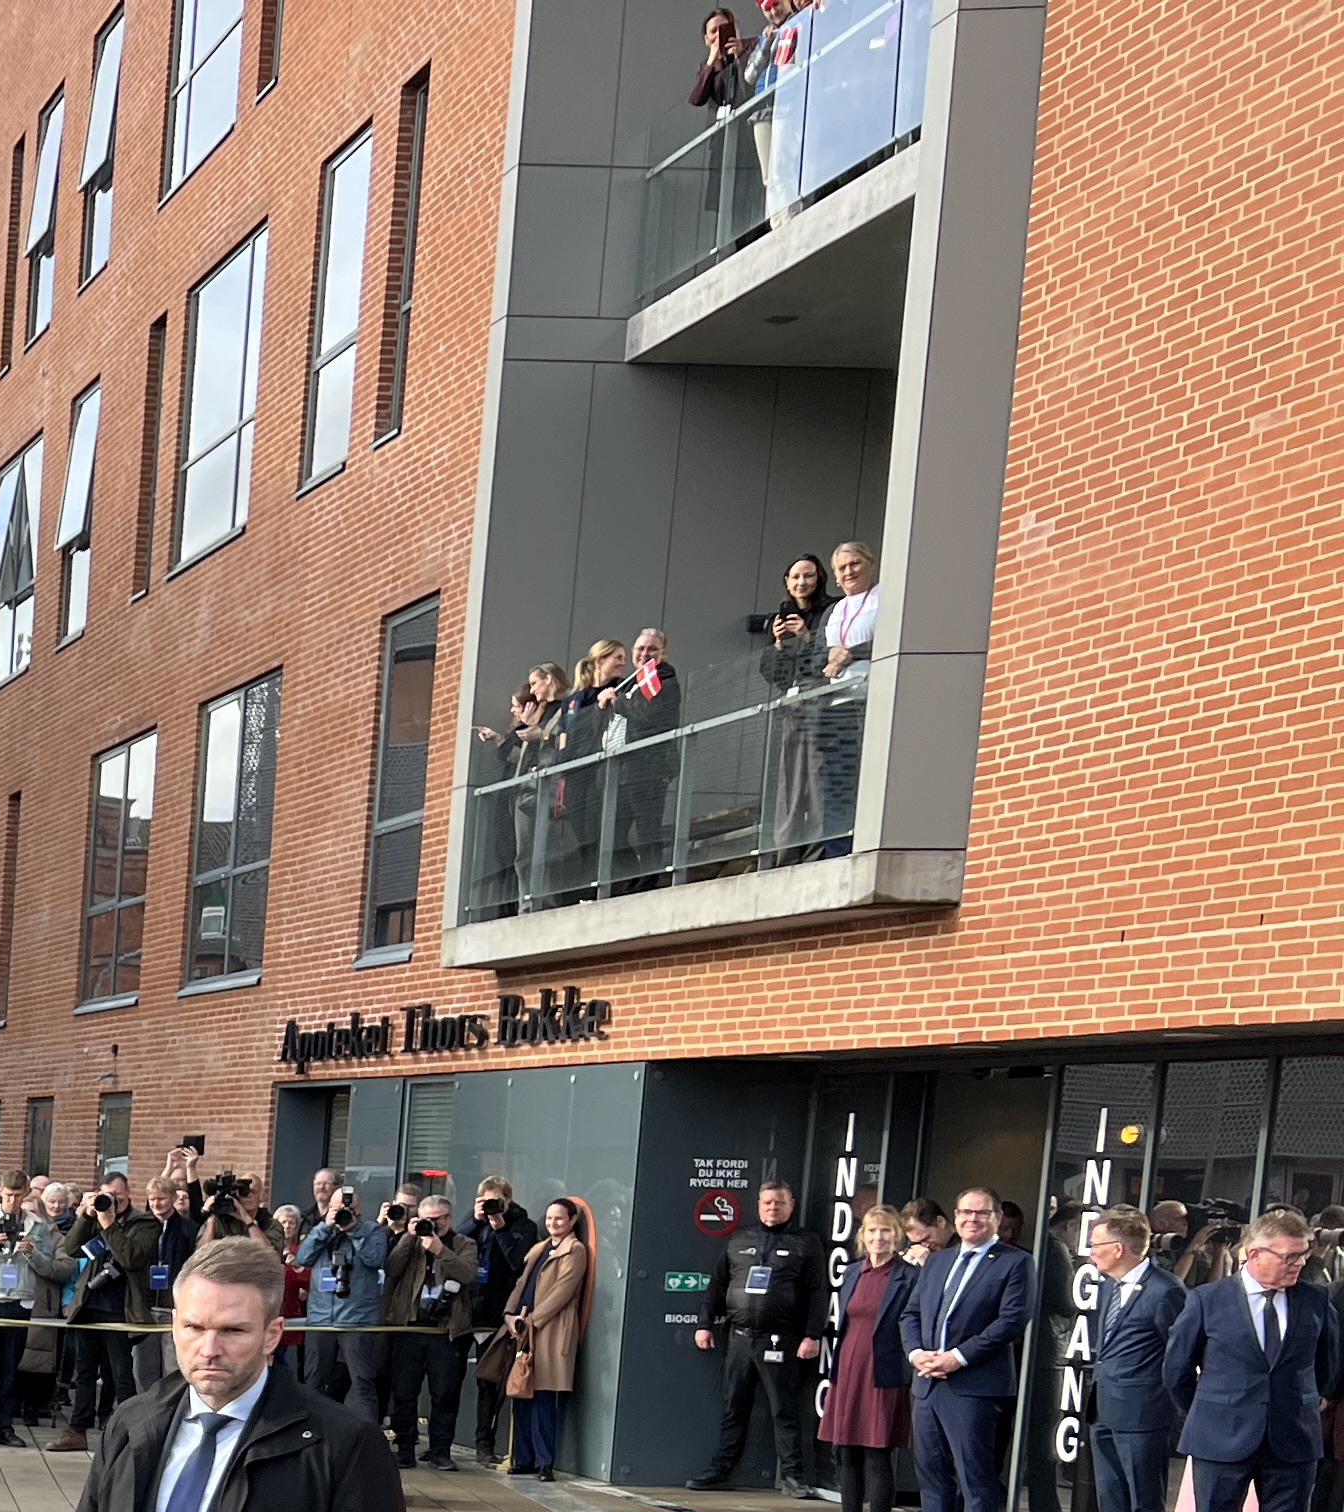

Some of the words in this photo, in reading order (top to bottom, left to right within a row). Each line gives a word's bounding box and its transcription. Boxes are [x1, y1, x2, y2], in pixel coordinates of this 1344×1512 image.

[279, 1011, 394, 1075] Apoteket
[401, 1002, 491, 1053] Thors
[494, 986, 610, 1047] Bakke
[693, 1158, 714, 1168] TAK
[716, 1159, 749, 1169] FORDI
[698, 1169, 713, 1178] DU
[715, 1169, 741, 1179] IKKE
[689, 1178, 724, 1188] RYGER
[726, 1179, 749, 1189] HER
